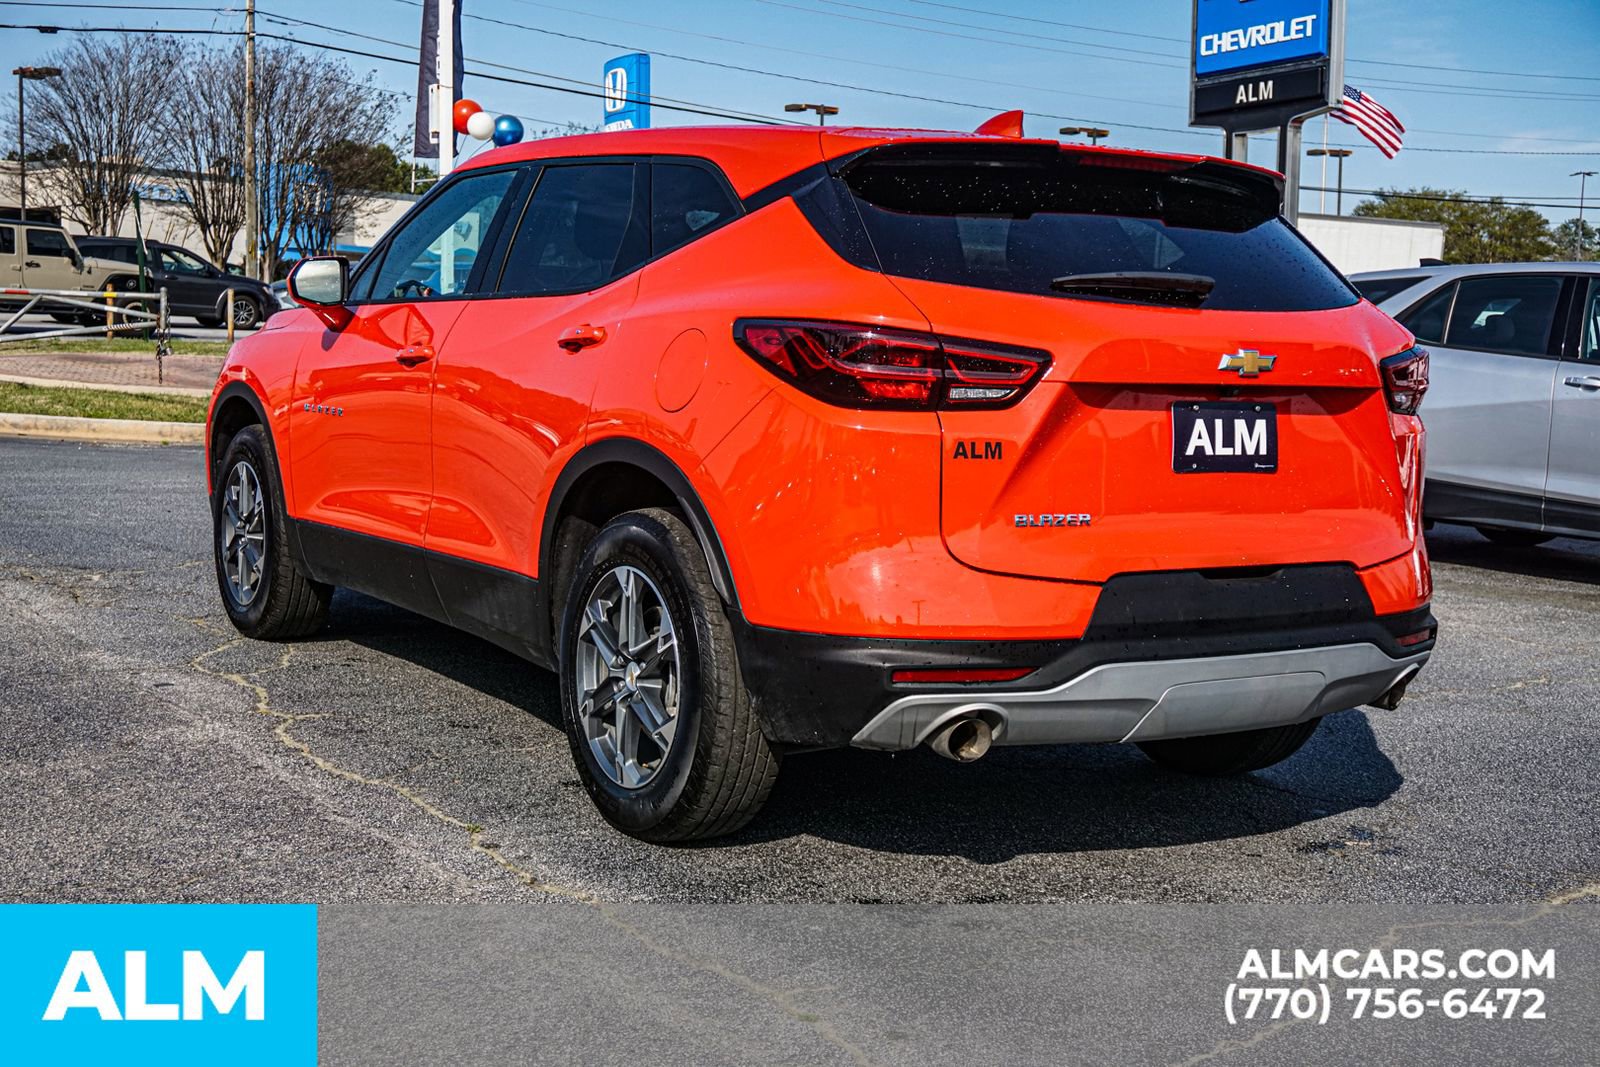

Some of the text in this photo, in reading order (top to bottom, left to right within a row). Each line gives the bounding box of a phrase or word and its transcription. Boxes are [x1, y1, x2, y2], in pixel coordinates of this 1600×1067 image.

[1200, 14, 1317, 56] CHEVROLET
[1235, 80, 1274, 104] ALM
[1185, 419, 1268, 456] ALM
[953, 441, 1003, 460] ALM
[1014, 513, 1092, 527] BLAZER
